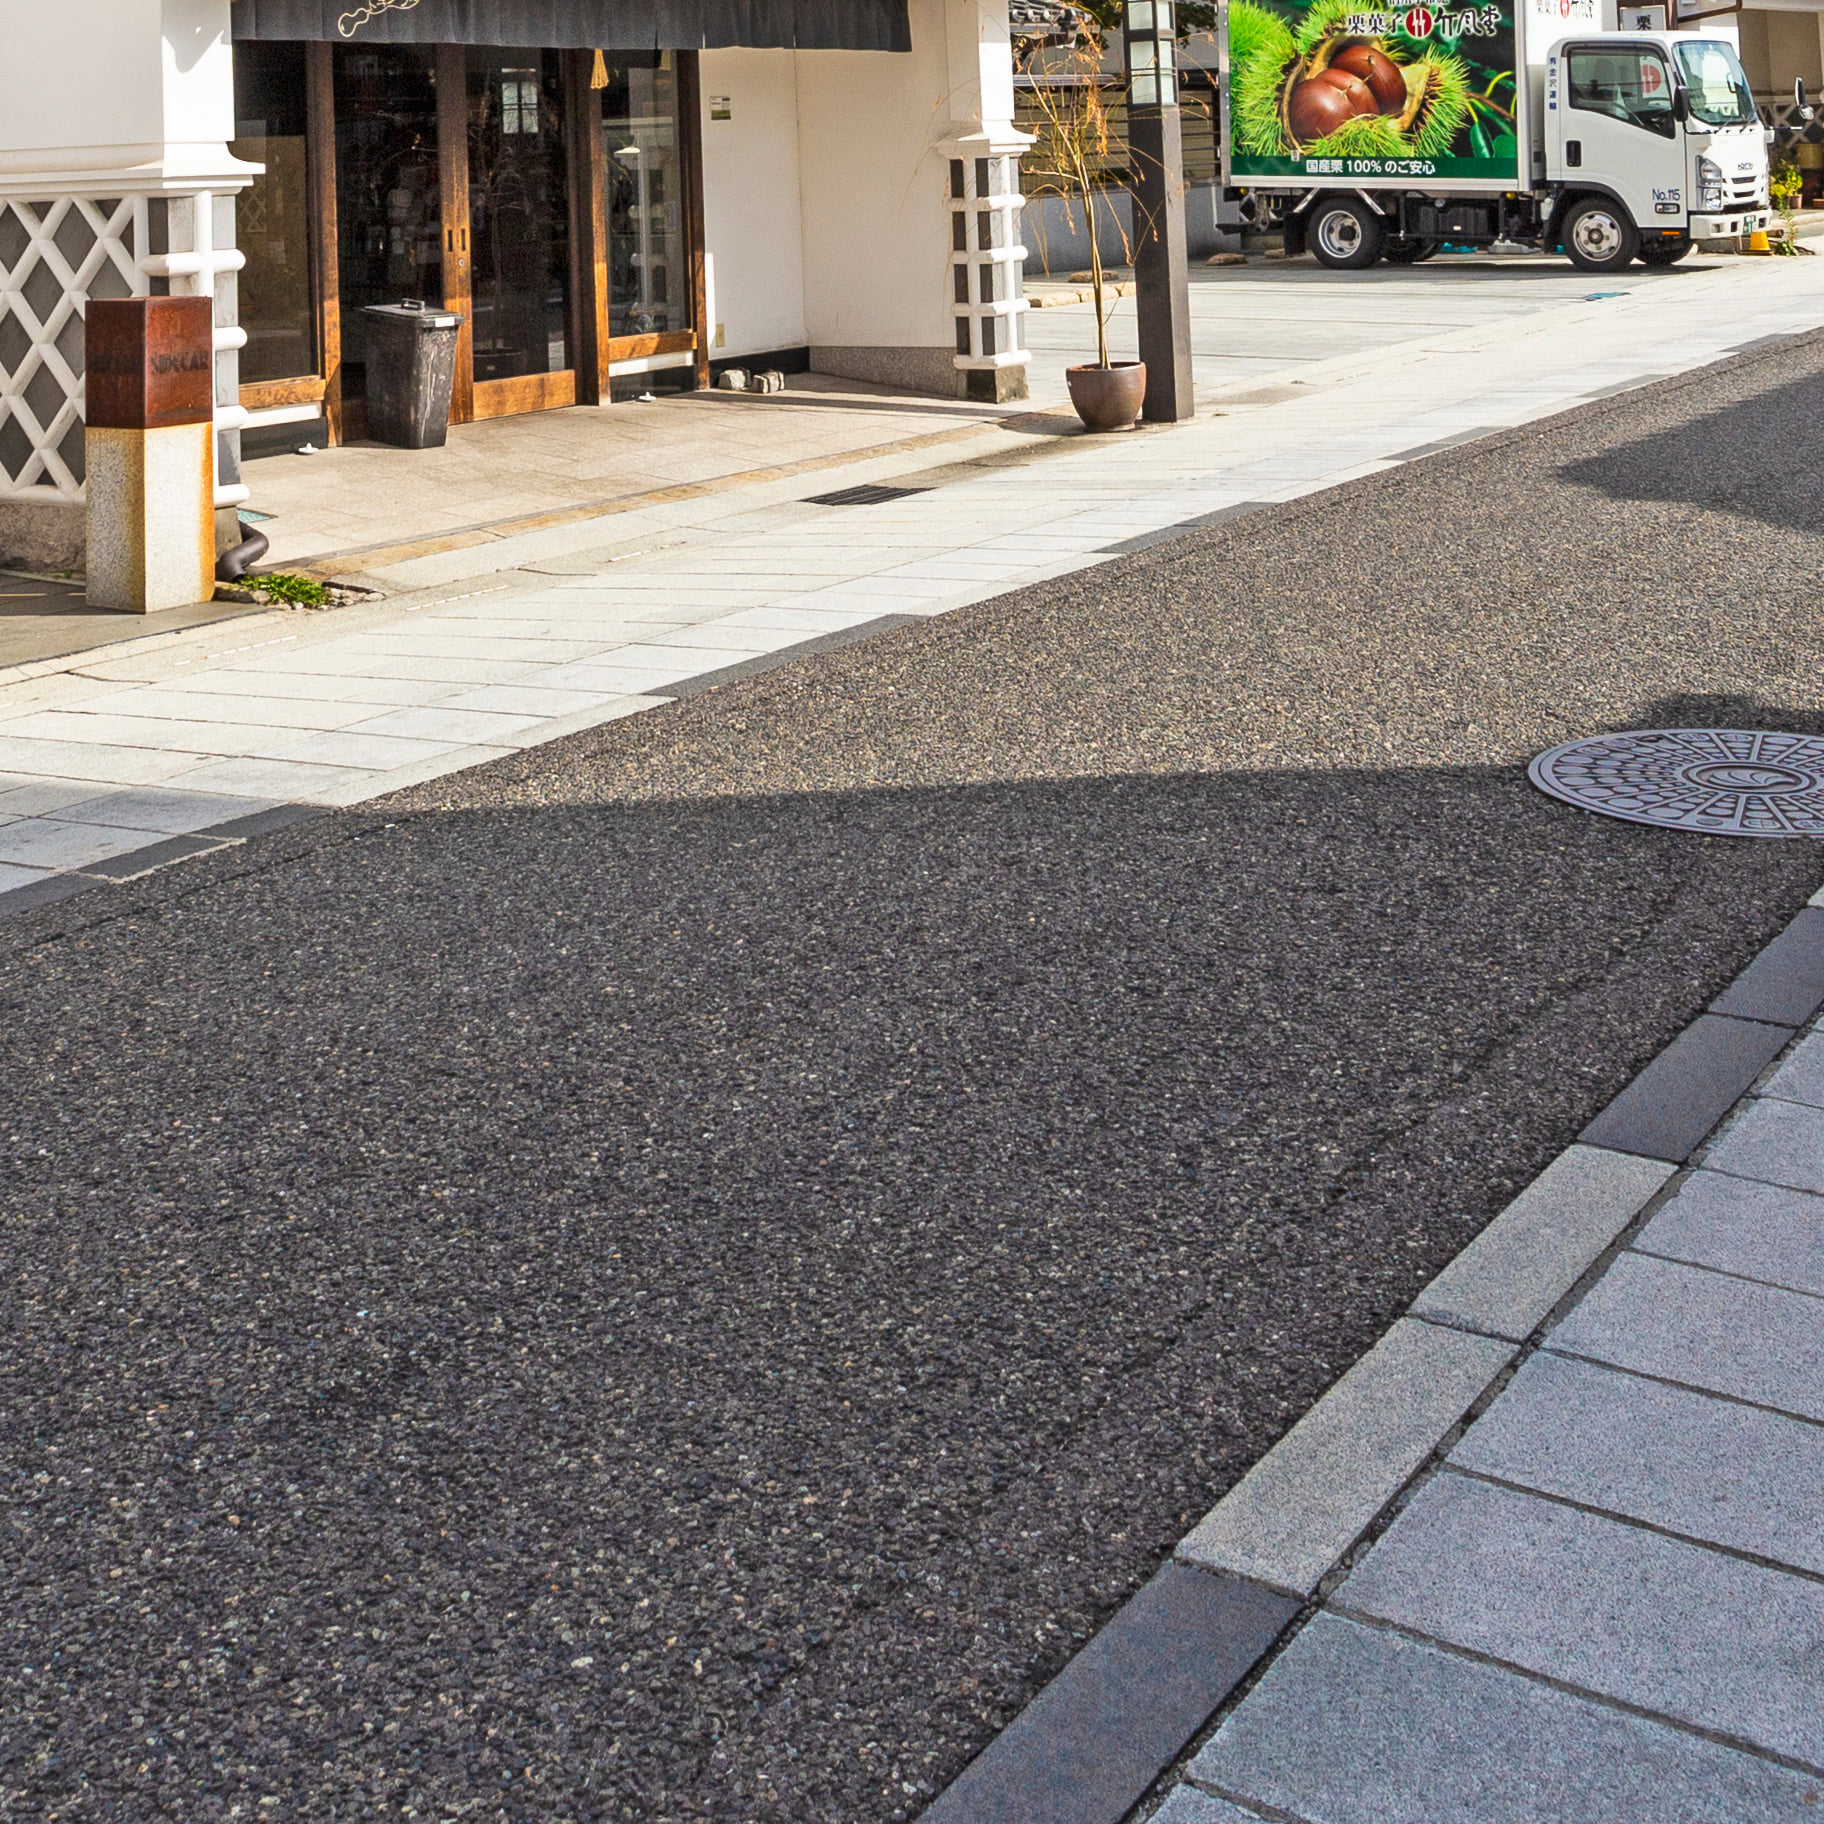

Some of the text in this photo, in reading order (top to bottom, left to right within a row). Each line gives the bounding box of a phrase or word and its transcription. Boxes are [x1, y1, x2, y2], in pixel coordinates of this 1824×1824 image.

[1347, 13, 1403, 35] 栗菓子
[1306, 159, 1436, 175] 国産栗 100% のご安心
